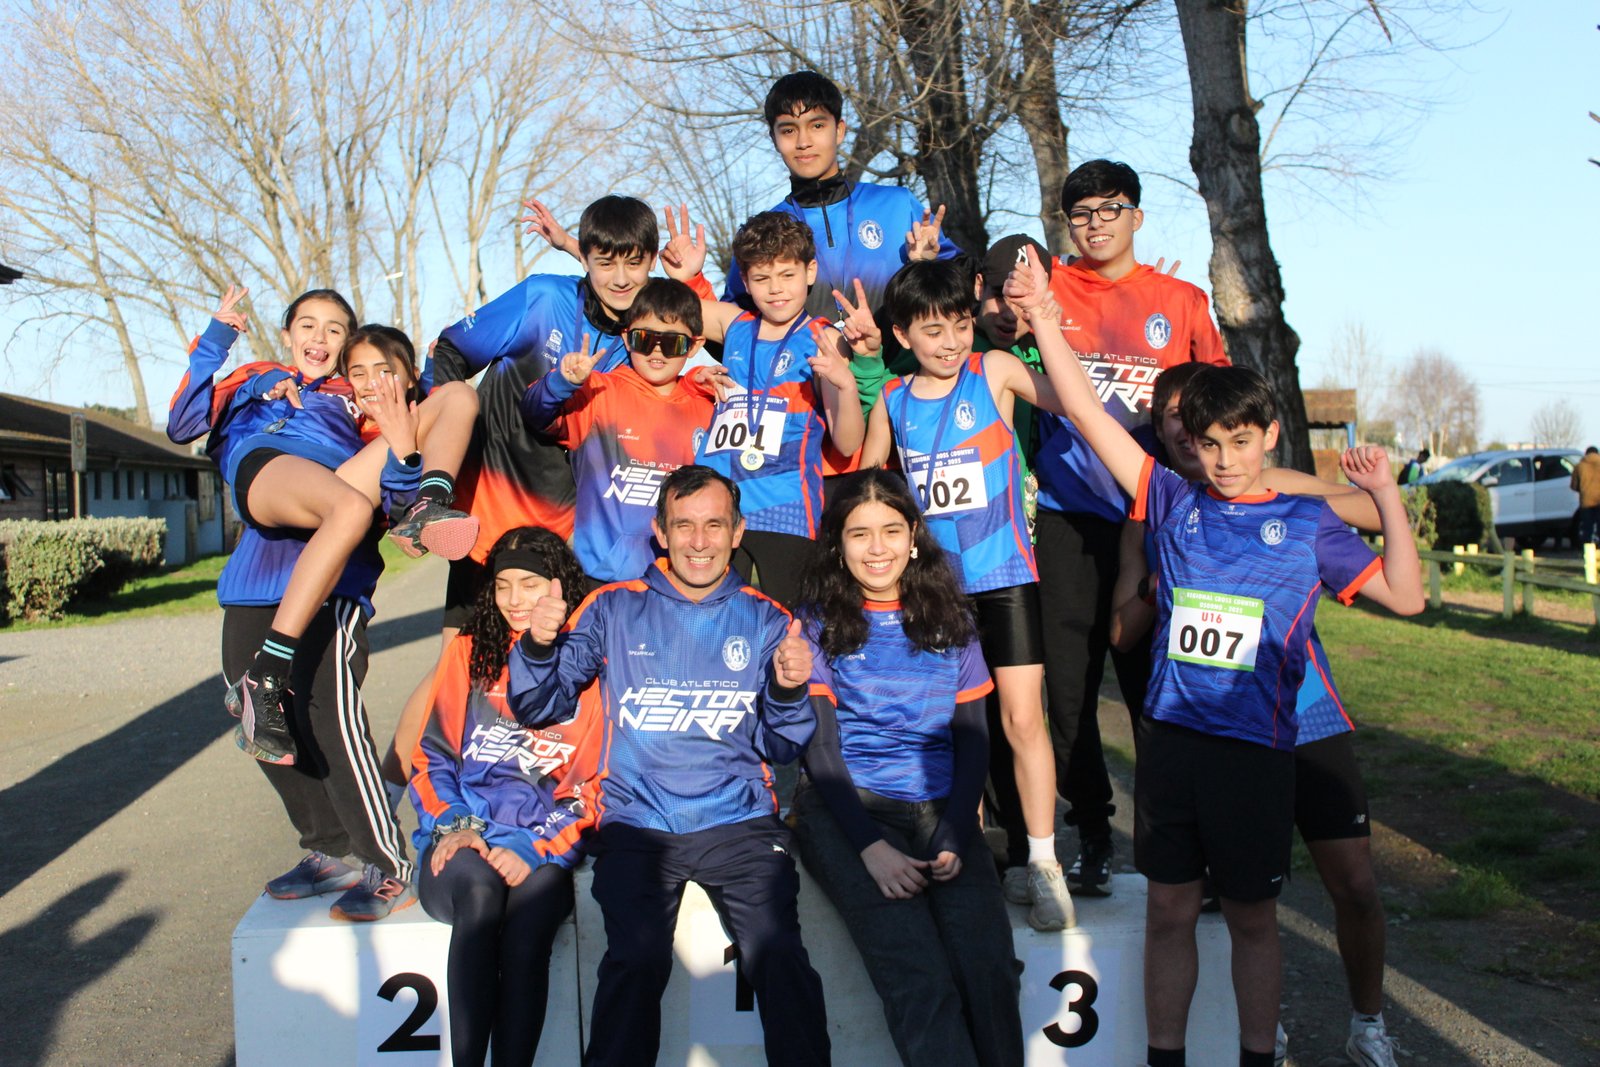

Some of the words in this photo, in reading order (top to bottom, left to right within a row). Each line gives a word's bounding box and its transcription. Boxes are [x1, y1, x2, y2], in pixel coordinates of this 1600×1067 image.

[1103, 353, 1158, 365] ATLETICO
[733, 410, 748, 419] U1
[715, 422, 765, 451] 001
[629, 459, 656, 468] CLUB
[934, 469, 946, 480] 14
[603, 480, 661, 507] NEI
[1201, 611, 1223, 624] U16
[1180, 624, 1244, 660] 007
[645, 677, 678, 686] CLUB
[680, 680, 739, 688] ATLETICO
[619, 687, 758, 714] HECTOR
[618, 705, 747, 741] NEIRA
[376, 971, 441, 1052] 2
[1042, 969, 1099, 1048] 3
